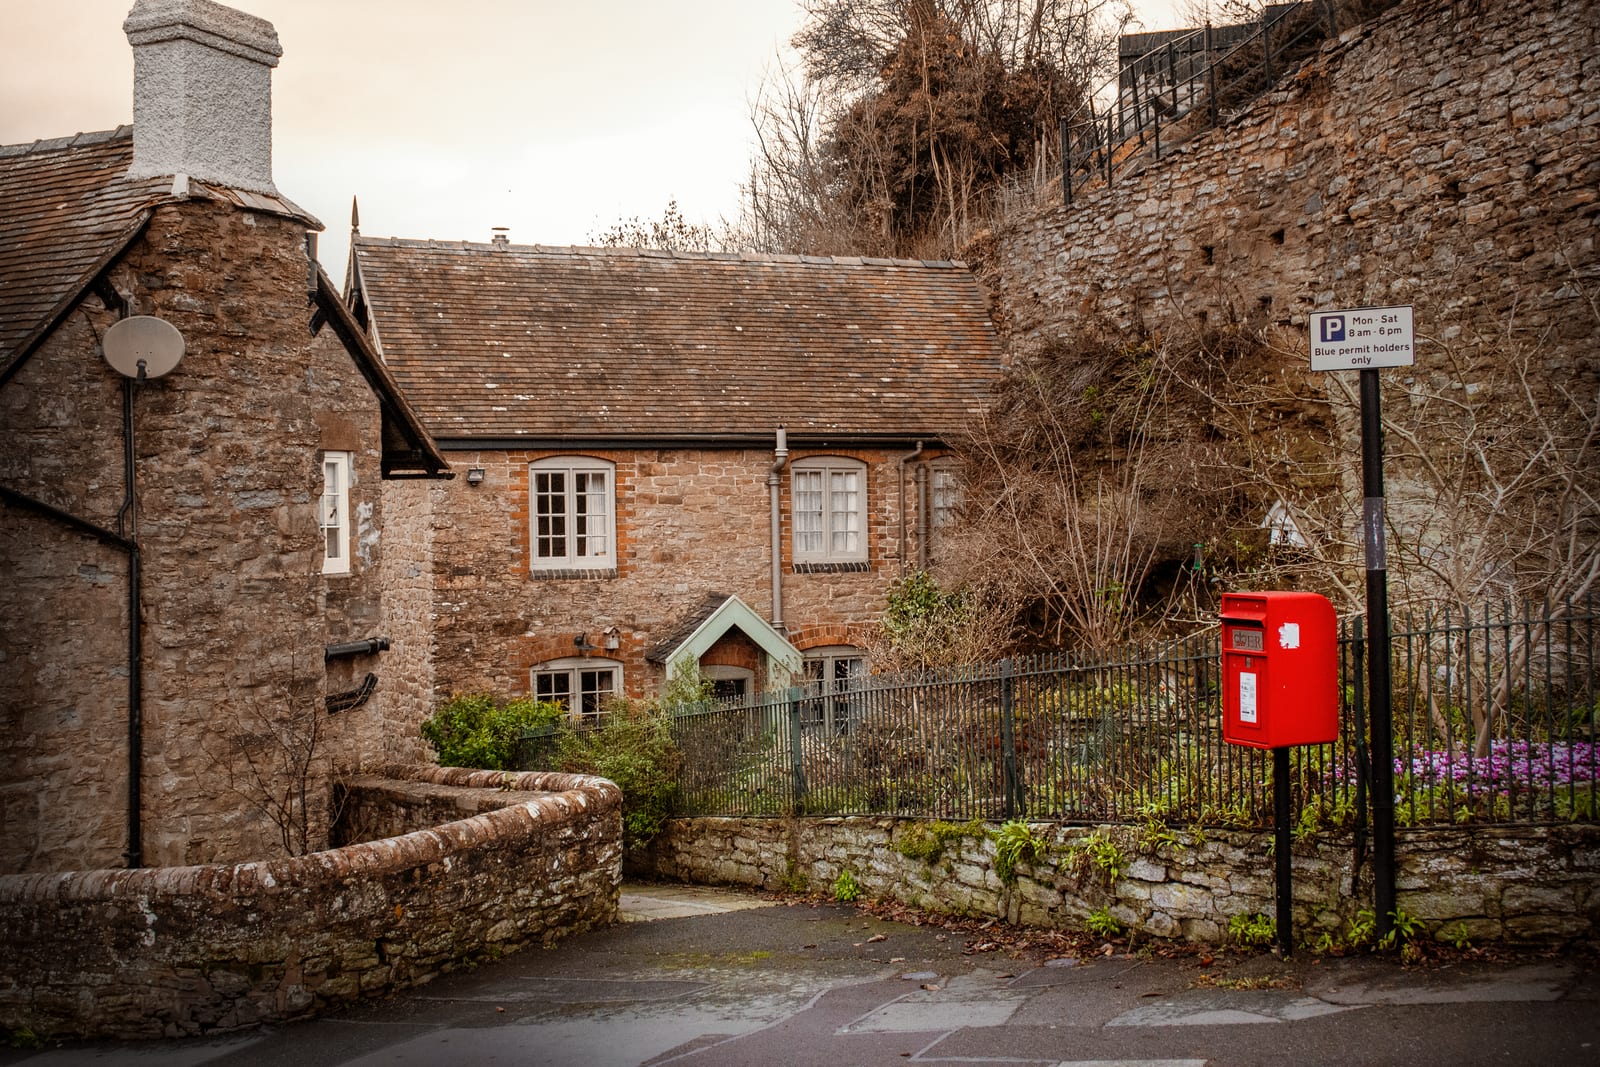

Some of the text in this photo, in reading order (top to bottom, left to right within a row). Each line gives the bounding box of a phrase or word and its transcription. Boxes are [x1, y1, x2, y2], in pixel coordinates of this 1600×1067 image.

[1352, 317, 1373, 325] Mon
[1381, 314, 1398, 323] Sat
[1326, 318, 1342, 340] P
[1348, 328, 1355, 337] 8
[1357, 329, 1371, 337] am
[1378, 327, 1385, 335] 6
[1387, 327, 1402, 336] pm
[1314, 343, 1410, 356] Blue permit holders
[1351, 356, 1372, 365] only
